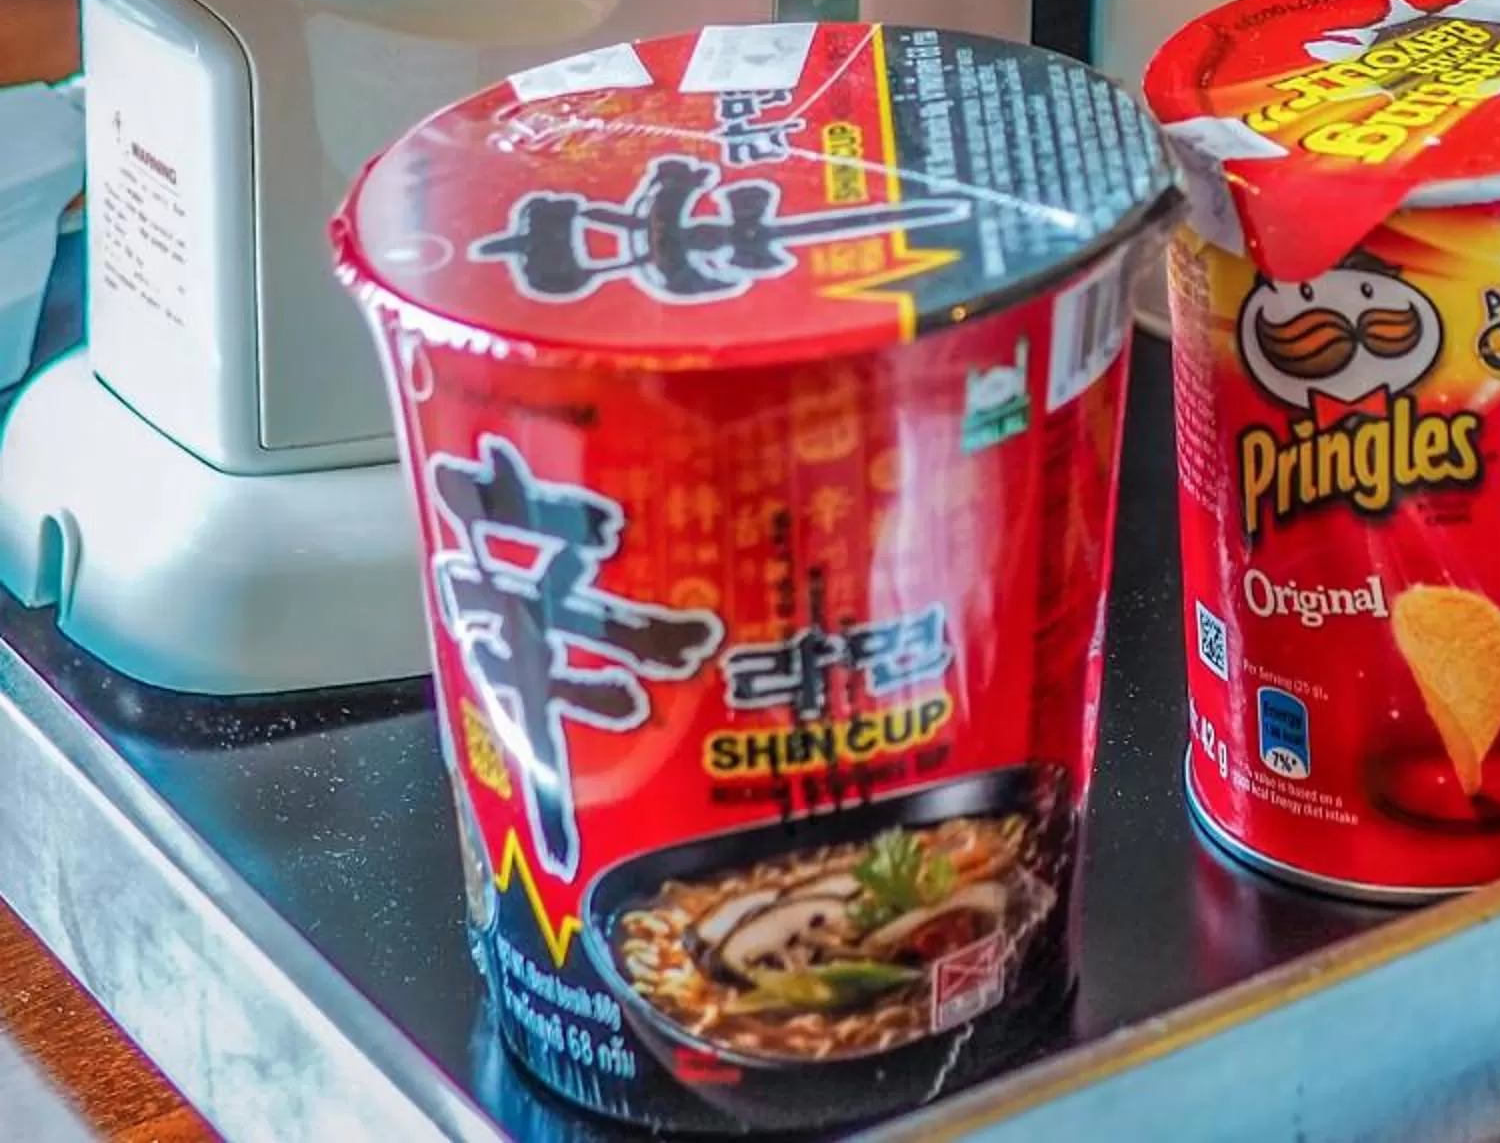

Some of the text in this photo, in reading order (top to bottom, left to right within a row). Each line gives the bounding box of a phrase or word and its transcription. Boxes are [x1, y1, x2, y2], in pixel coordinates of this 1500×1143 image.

[468, 154, 971, 303] 辛
[1240, 394, 1481, 537] Pringles
[1243, 568, 1389, 628] Original
[427, 432, 725, 883] 辛
[846, 698, 950, 756] CUP
[1318, 791, 1334, 806] on
[565, 1023, 594, 1067] 68
